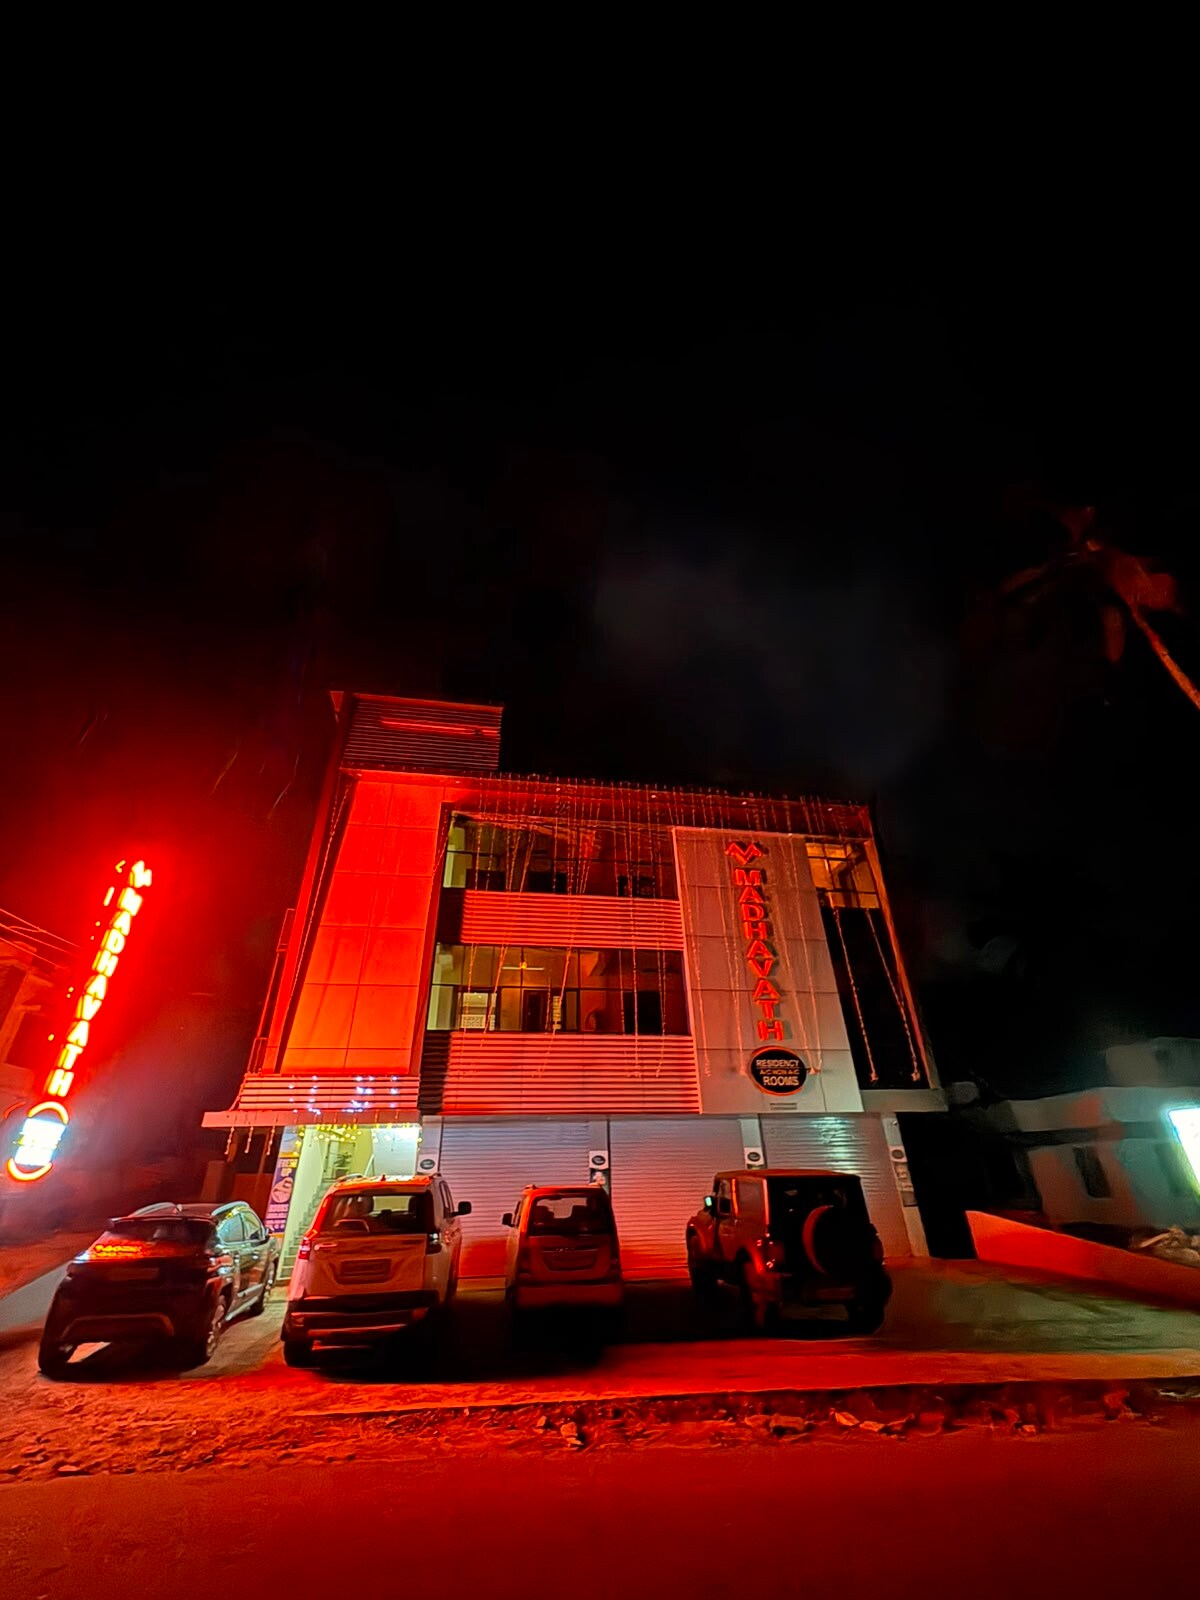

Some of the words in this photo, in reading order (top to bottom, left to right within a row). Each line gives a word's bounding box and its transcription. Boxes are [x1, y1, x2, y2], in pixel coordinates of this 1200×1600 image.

[45, 886, 143, 1098] MADHAVATH
[734, 868, 785, 1041] MADHAVATH
[755, 1059, 799, 1067] RESIDENCY
[763, 1076, 799, 1086] ROOMS
